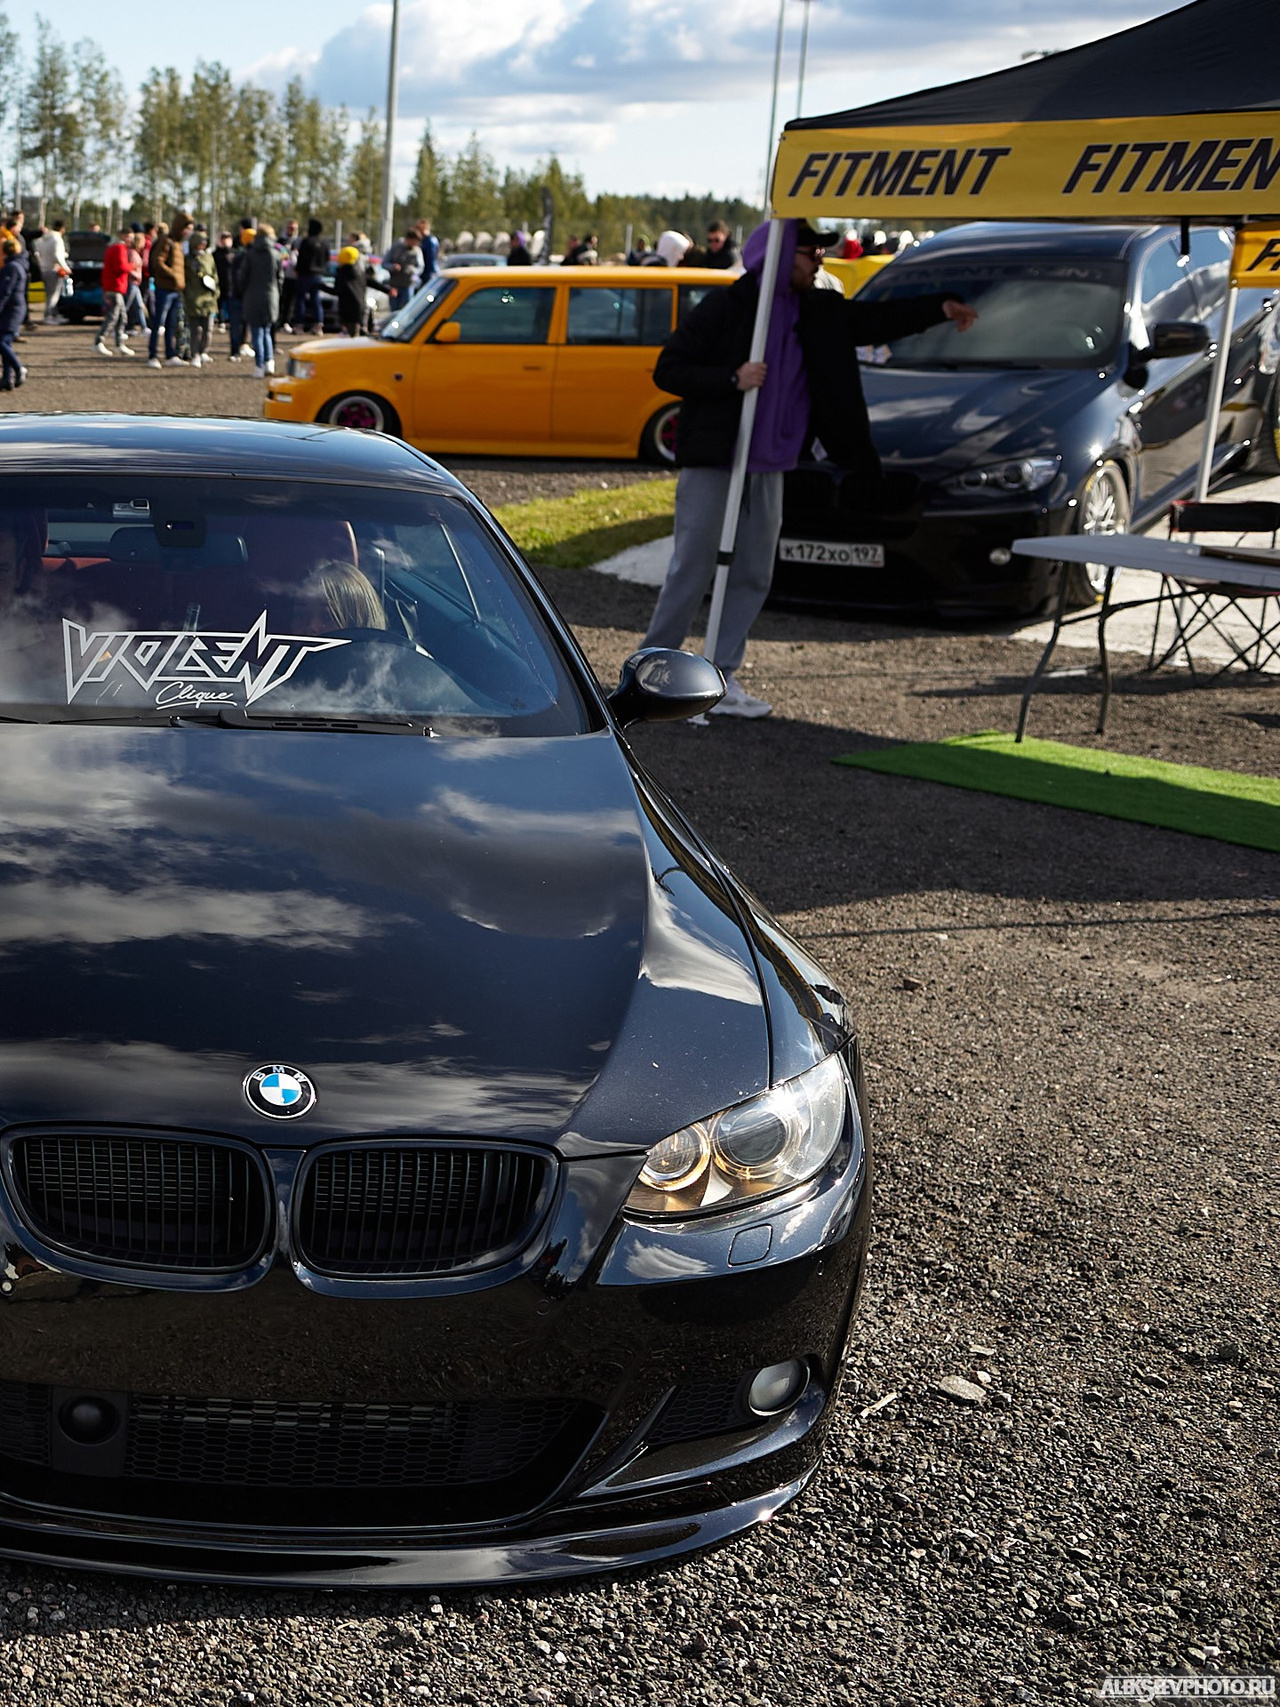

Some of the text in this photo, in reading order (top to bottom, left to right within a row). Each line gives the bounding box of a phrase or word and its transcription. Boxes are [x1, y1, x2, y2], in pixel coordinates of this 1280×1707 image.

[787, 147, 1013, 197] FITMENT
[62, 609, 352, 706] VIOLENT
[156, 681, 236, 709] Clique
